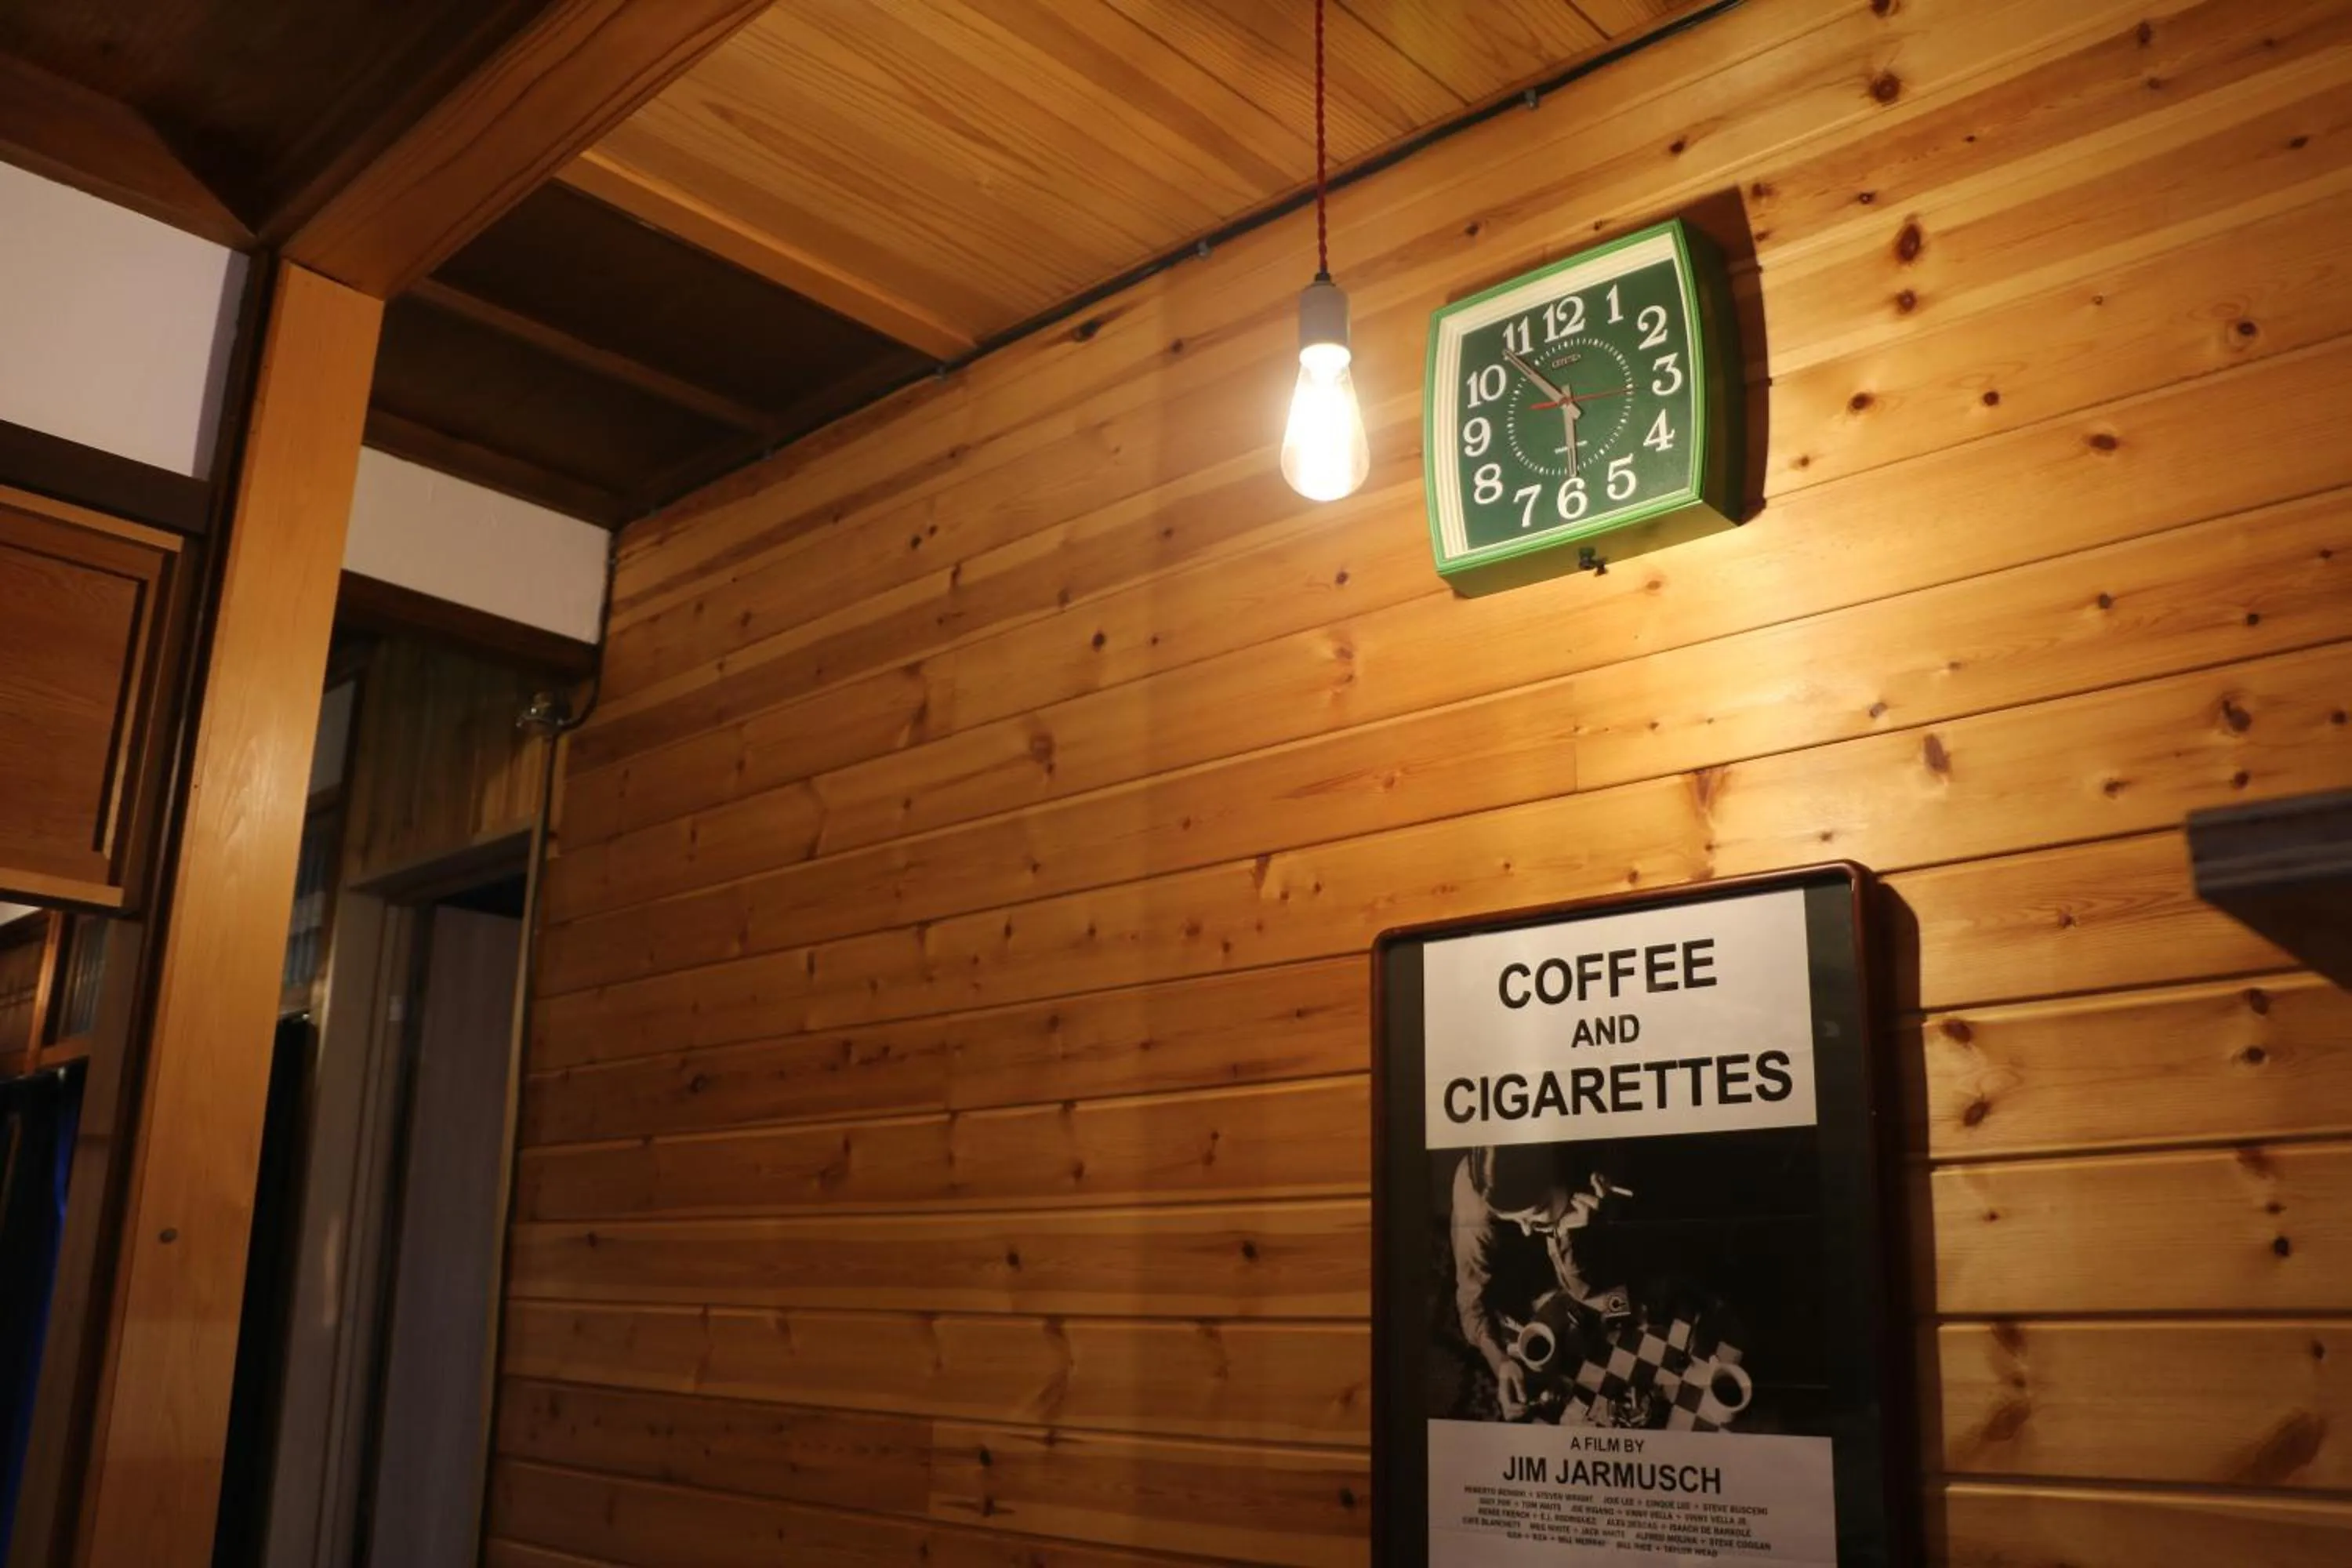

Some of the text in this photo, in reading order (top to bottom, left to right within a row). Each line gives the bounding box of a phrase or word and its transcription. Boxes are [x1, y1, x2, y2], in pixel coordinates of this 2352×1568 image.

[1542, 295, 1586, 344] 12
[1606, 283, 1624, 325] 1
[1501, 315, 1534, 360] 11
[1637, 305, 1668, 350] 2
[1466, 364, 1507, 409] 10
[1651, 352, 1682, 396] 3
[1462, 417, 1491, 457] 9
[1642, 408, 1675, 452] 4
[1473, 463, 1504, 505] 8
[1557, 477, 1588, 520] 6
[1606, 453, 1637, 500] 5
[1513, 484, 1542, 528] 7
[1498, 938, 1718, 1009] COFFEE
[1570, 1014, 1640, 1048] AND
[1443, 1050, 1793, 1123] CIGARETTES
[1570, 1436, 1645, 1453] A FILM BY
[1503, 1455, 1722, 1494] JIM JARMUSCH
